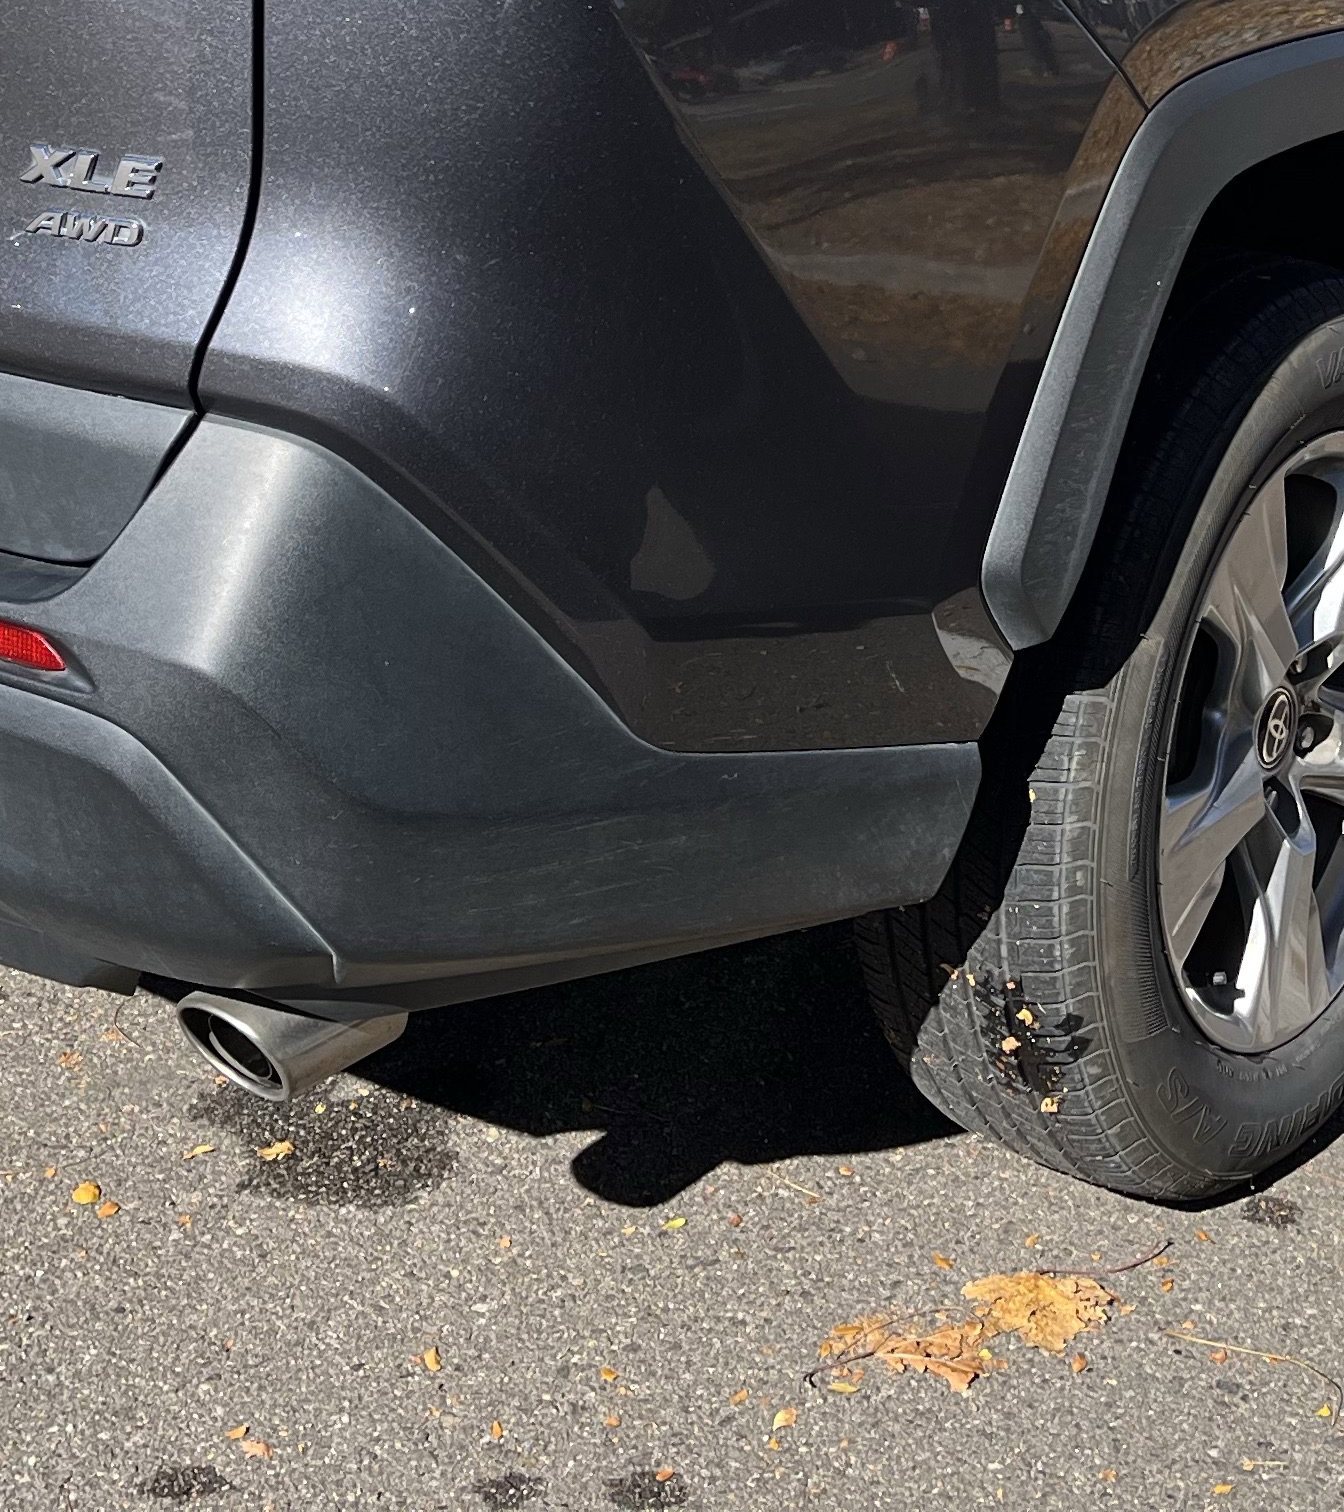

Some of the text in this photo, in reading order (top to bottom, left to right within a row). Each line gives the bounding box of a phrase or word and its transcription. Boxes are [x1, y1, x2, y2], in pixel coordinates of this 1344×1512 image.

[19, 143, 164, 199] XLE
[24, 207, 145, 247] AWD
[1156, 1065, 1228, 1145] A/S
